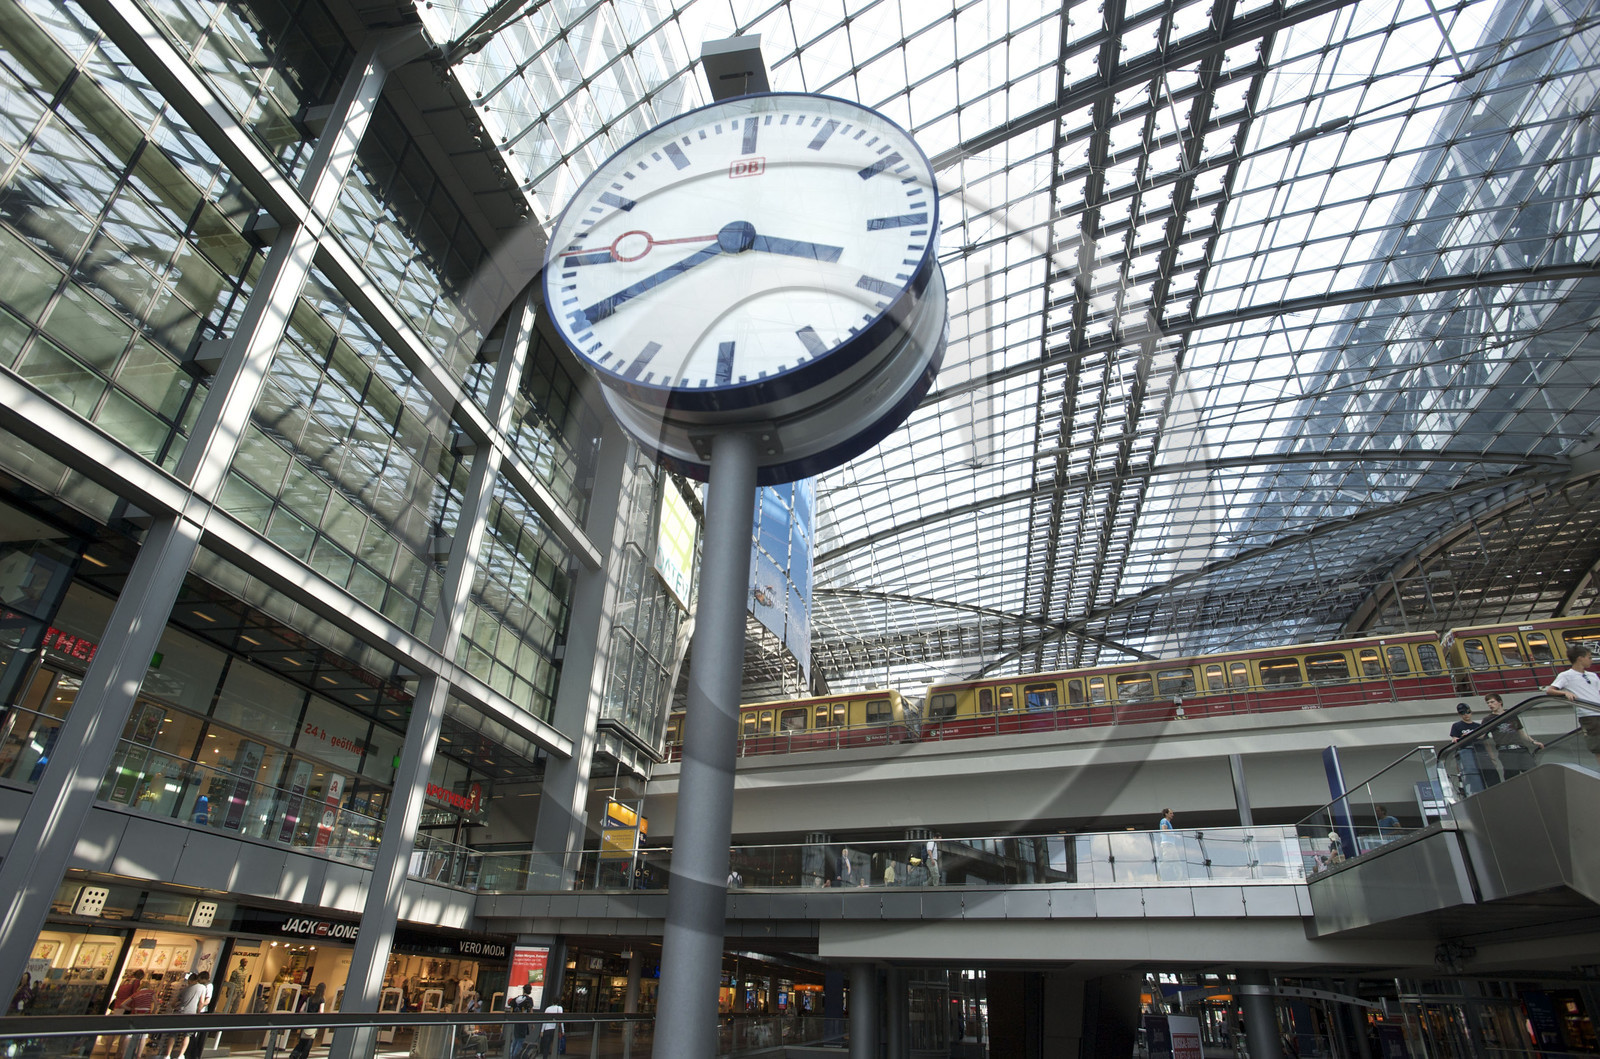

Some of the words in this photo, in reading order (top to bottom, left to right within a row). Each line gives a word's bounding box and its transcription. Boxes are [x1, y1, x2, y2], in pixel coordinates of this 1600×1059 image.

[734, 161, 759, 175] DB
[656, 545, 688, 601] DATEV
[305, 723, 319, 737] 24
[320, 729, 327, 740] h
[331, 736, 366, 756] geöffnet
[426, 783, 471, 811] APOTHEKE
[281, 918, 319, 934] JACK
[327, 924, 360, 939] JONE
[459, 941, 481, 954] VERO
[481, 944, 505, 957] MODA
